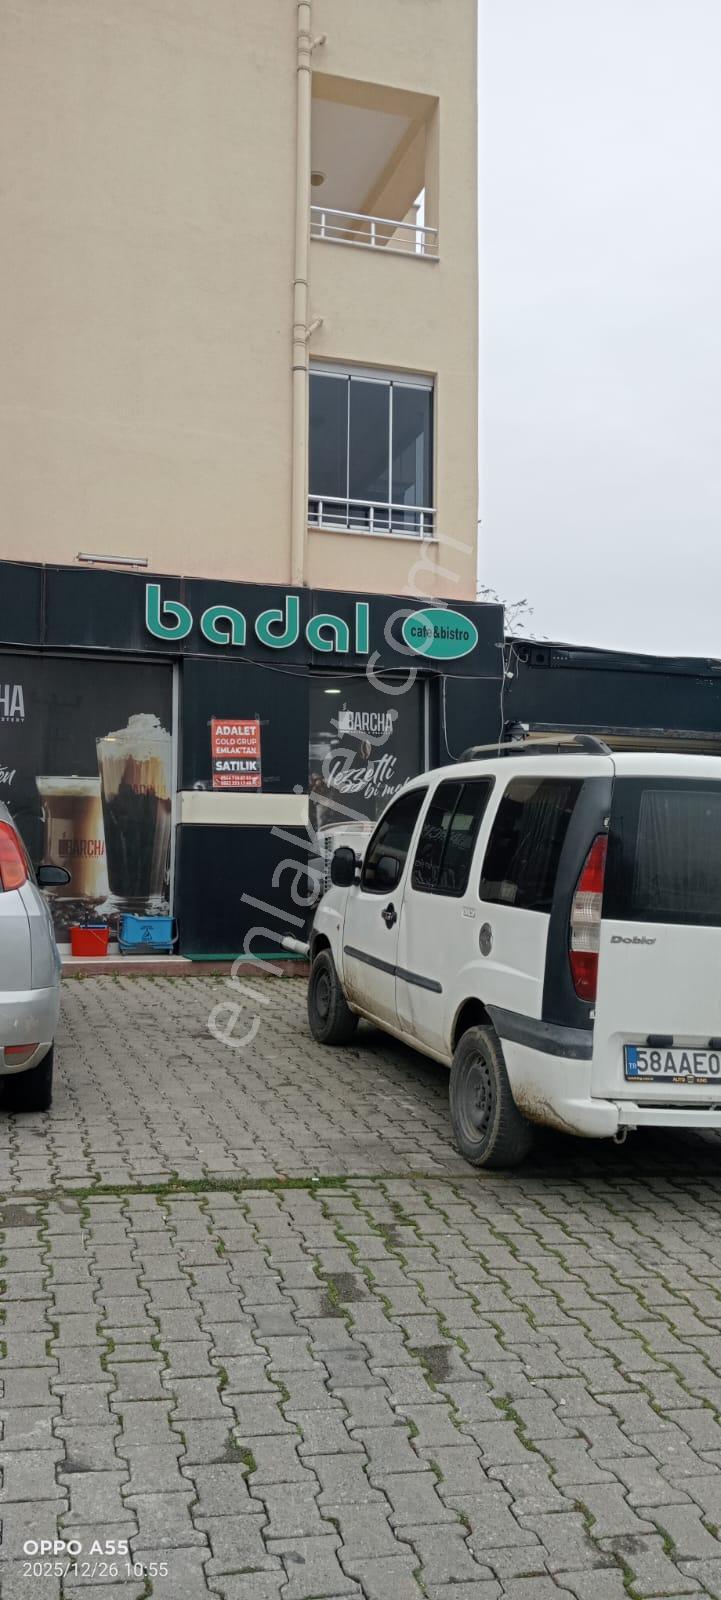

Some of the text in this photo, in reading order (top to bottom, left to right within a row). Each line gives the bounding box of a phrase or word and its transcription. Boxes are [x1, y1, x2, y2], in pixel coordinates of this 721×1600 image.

[145, 583, 369, 654] badal
[410, 626, 470, 641] cafe&bistro
[343, 711, 394, 732] BARCHA
[216, 726, 256, 735] ADALET
[215, 760, 257, 771] SATILIK
